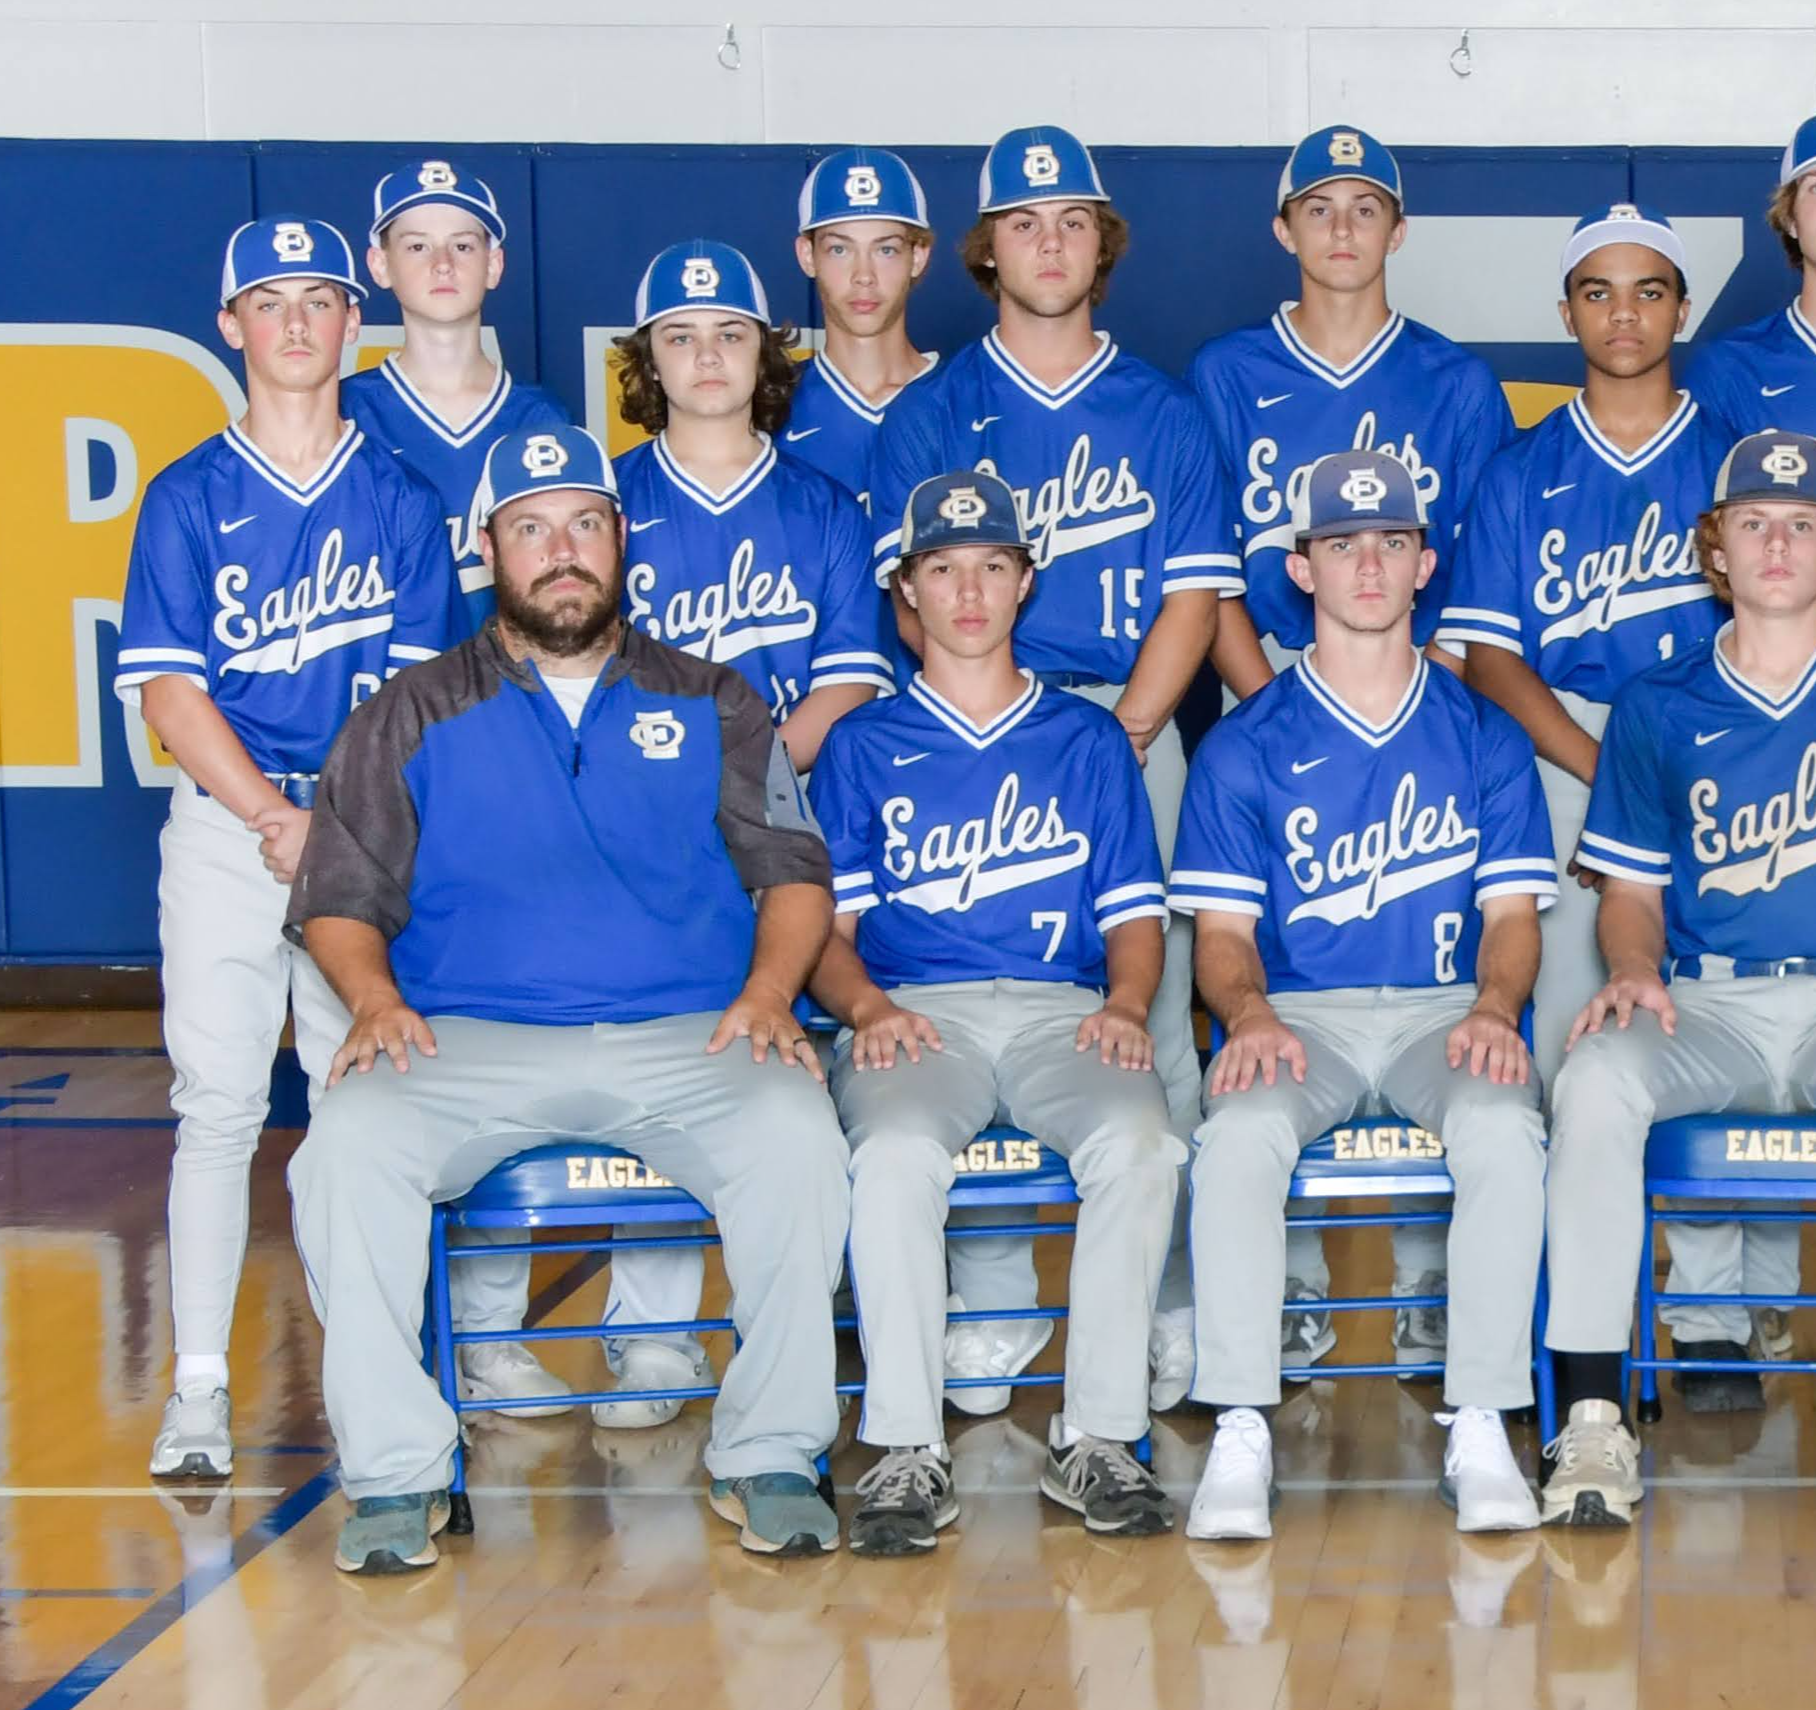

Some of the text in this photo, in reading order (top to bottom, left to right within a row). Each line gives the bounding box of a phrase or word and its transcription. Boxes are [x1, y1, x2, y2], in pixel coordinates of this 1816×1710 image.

[214, 529, 396, 675] Eagles
[626, 538, 817, 664] Eagles
[1100, 568, 1145, 641] 15
[881, 772, 1090, 913] Eagles
[1285, 772, 1480, 920] Eagles
[1031, 911, 1067, 963] 7
[1433, 912, 1463, 984] 8
[1334, 1127, 1443, 1159] EAGLES
